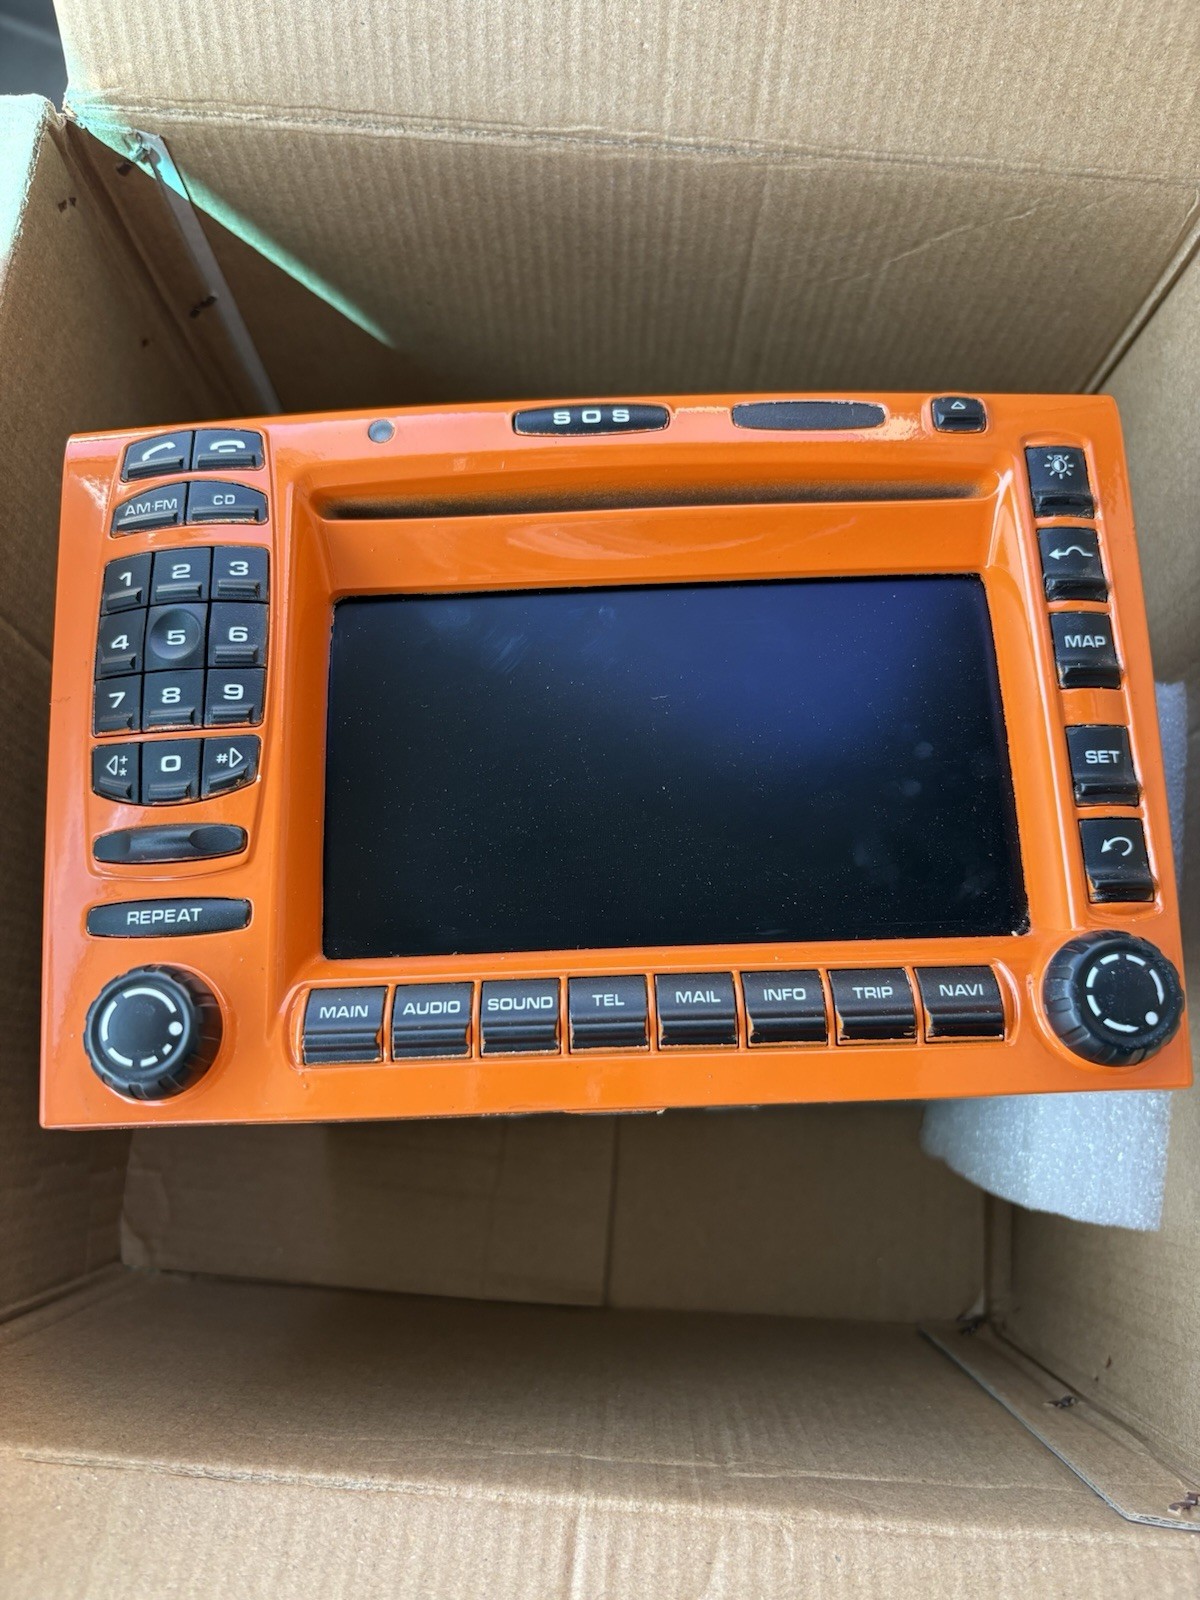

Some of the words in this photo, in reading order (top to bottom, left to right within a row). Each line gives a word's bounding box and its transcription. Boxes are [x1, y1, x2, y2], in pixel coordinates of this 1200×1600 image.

[553, 408, 631, 425] SOS
[212, 494, 236, 506] CD
[172, 563, 191, 579] 2
[229, 561, 249, 576] 3
[119, 571, 132, 587] 1
[111, 634, 129, 650] 4
[166, 629, 186, 645] 5
[228, 626, 248, 642] 6
[1064, 635, 1107, 649] MAP
[162, 687, 181, 704] 8
[223, 683, 244, 700] 9
[109, 691, 126, 709] 7
[160, 755, 181, 772] 0
[1085, 749, 1120, 765] SET
[126, 907, 203, 926] REPEAT
[675, 990, 721, 1004] MAIL
[763, 987, 807, 1002] INFO
[852, 986, 894, 1000] TRIP
[939, 983, 985, 998] NAVI
[402, 1000, 461, 1016] AUDIO
[487, 995, 554, 1012] SOUND
[592, 993, 625, 1008] TEL
[319, 1005, 369, 1020] MAIN
